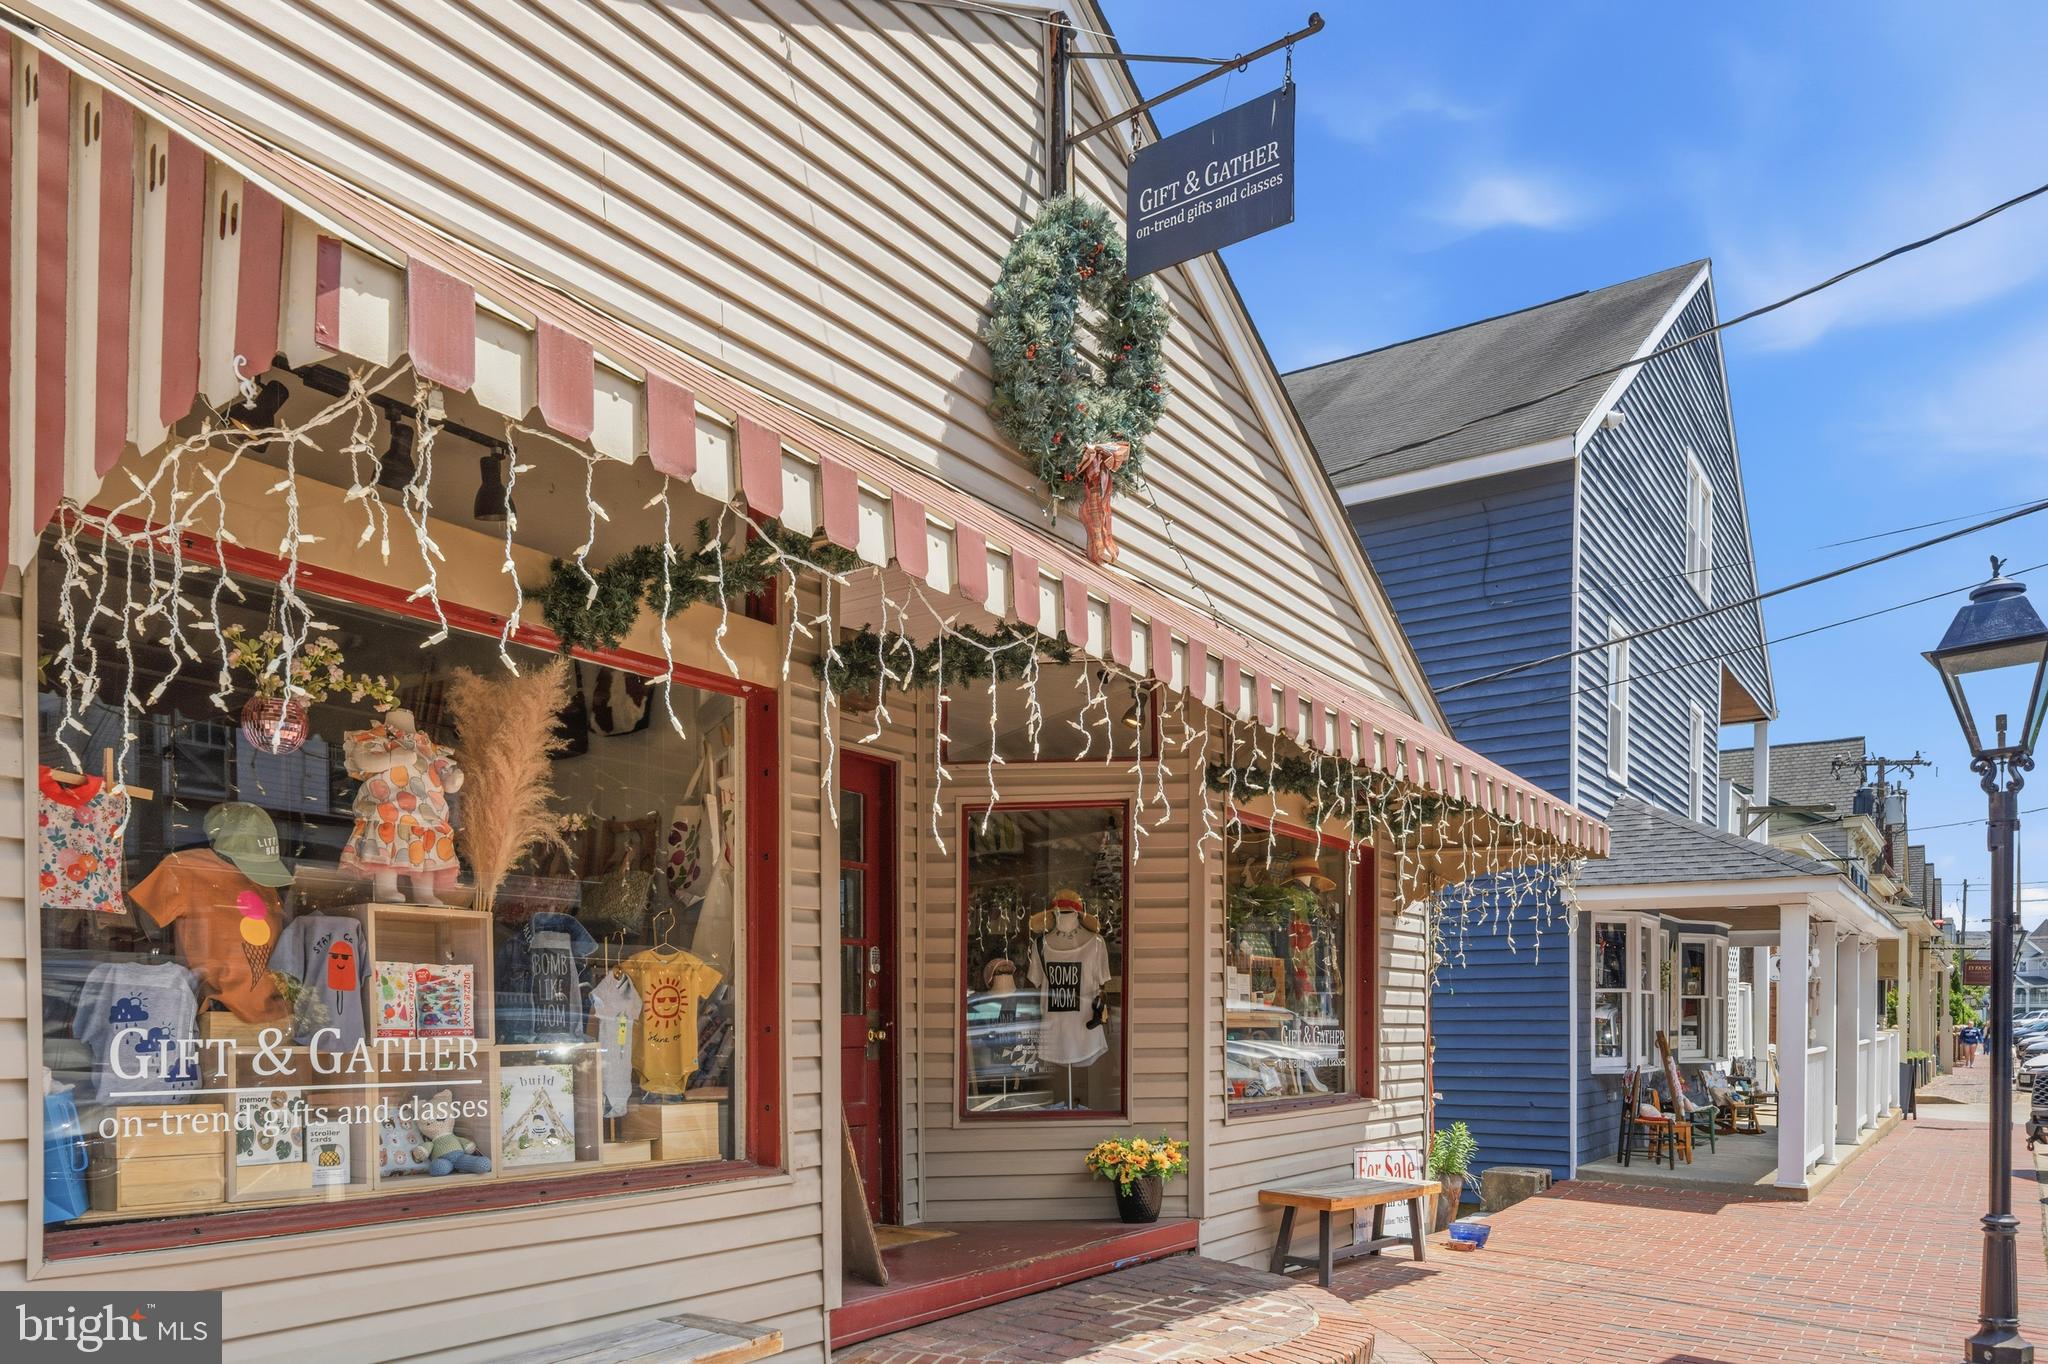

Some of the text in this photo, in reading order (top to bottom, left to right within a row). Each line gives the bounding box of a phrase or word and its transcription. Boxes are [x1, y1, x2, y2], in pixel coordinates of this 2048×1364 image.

[1140, 141, 1280, 213] GIFT & GATHER
[1136, 173, 1283, 239] on-trend gifts and classes
[531, 952, 568, 976] BOMB
[1048, 965, 1079, 986] BOMB
[463, 974, 471, 1028] PUZZLE SNAX
[1051, 987, 1076, 1009] MOM
[536, 1003, 566, 1028] MOM
[1303, 1025, 1312, 1047] &
[110, 1027, 478, 1081] GIFT & GATHER
[519, 1075, 555, 1087] build
[239, 1095, 269, 1105] memory
[99, 1095, 489, 1139] on-trend gifts and classes
[310, 1129, 340, 1137] stroller
[1359, 1154, 1415, 1179] For Sale
